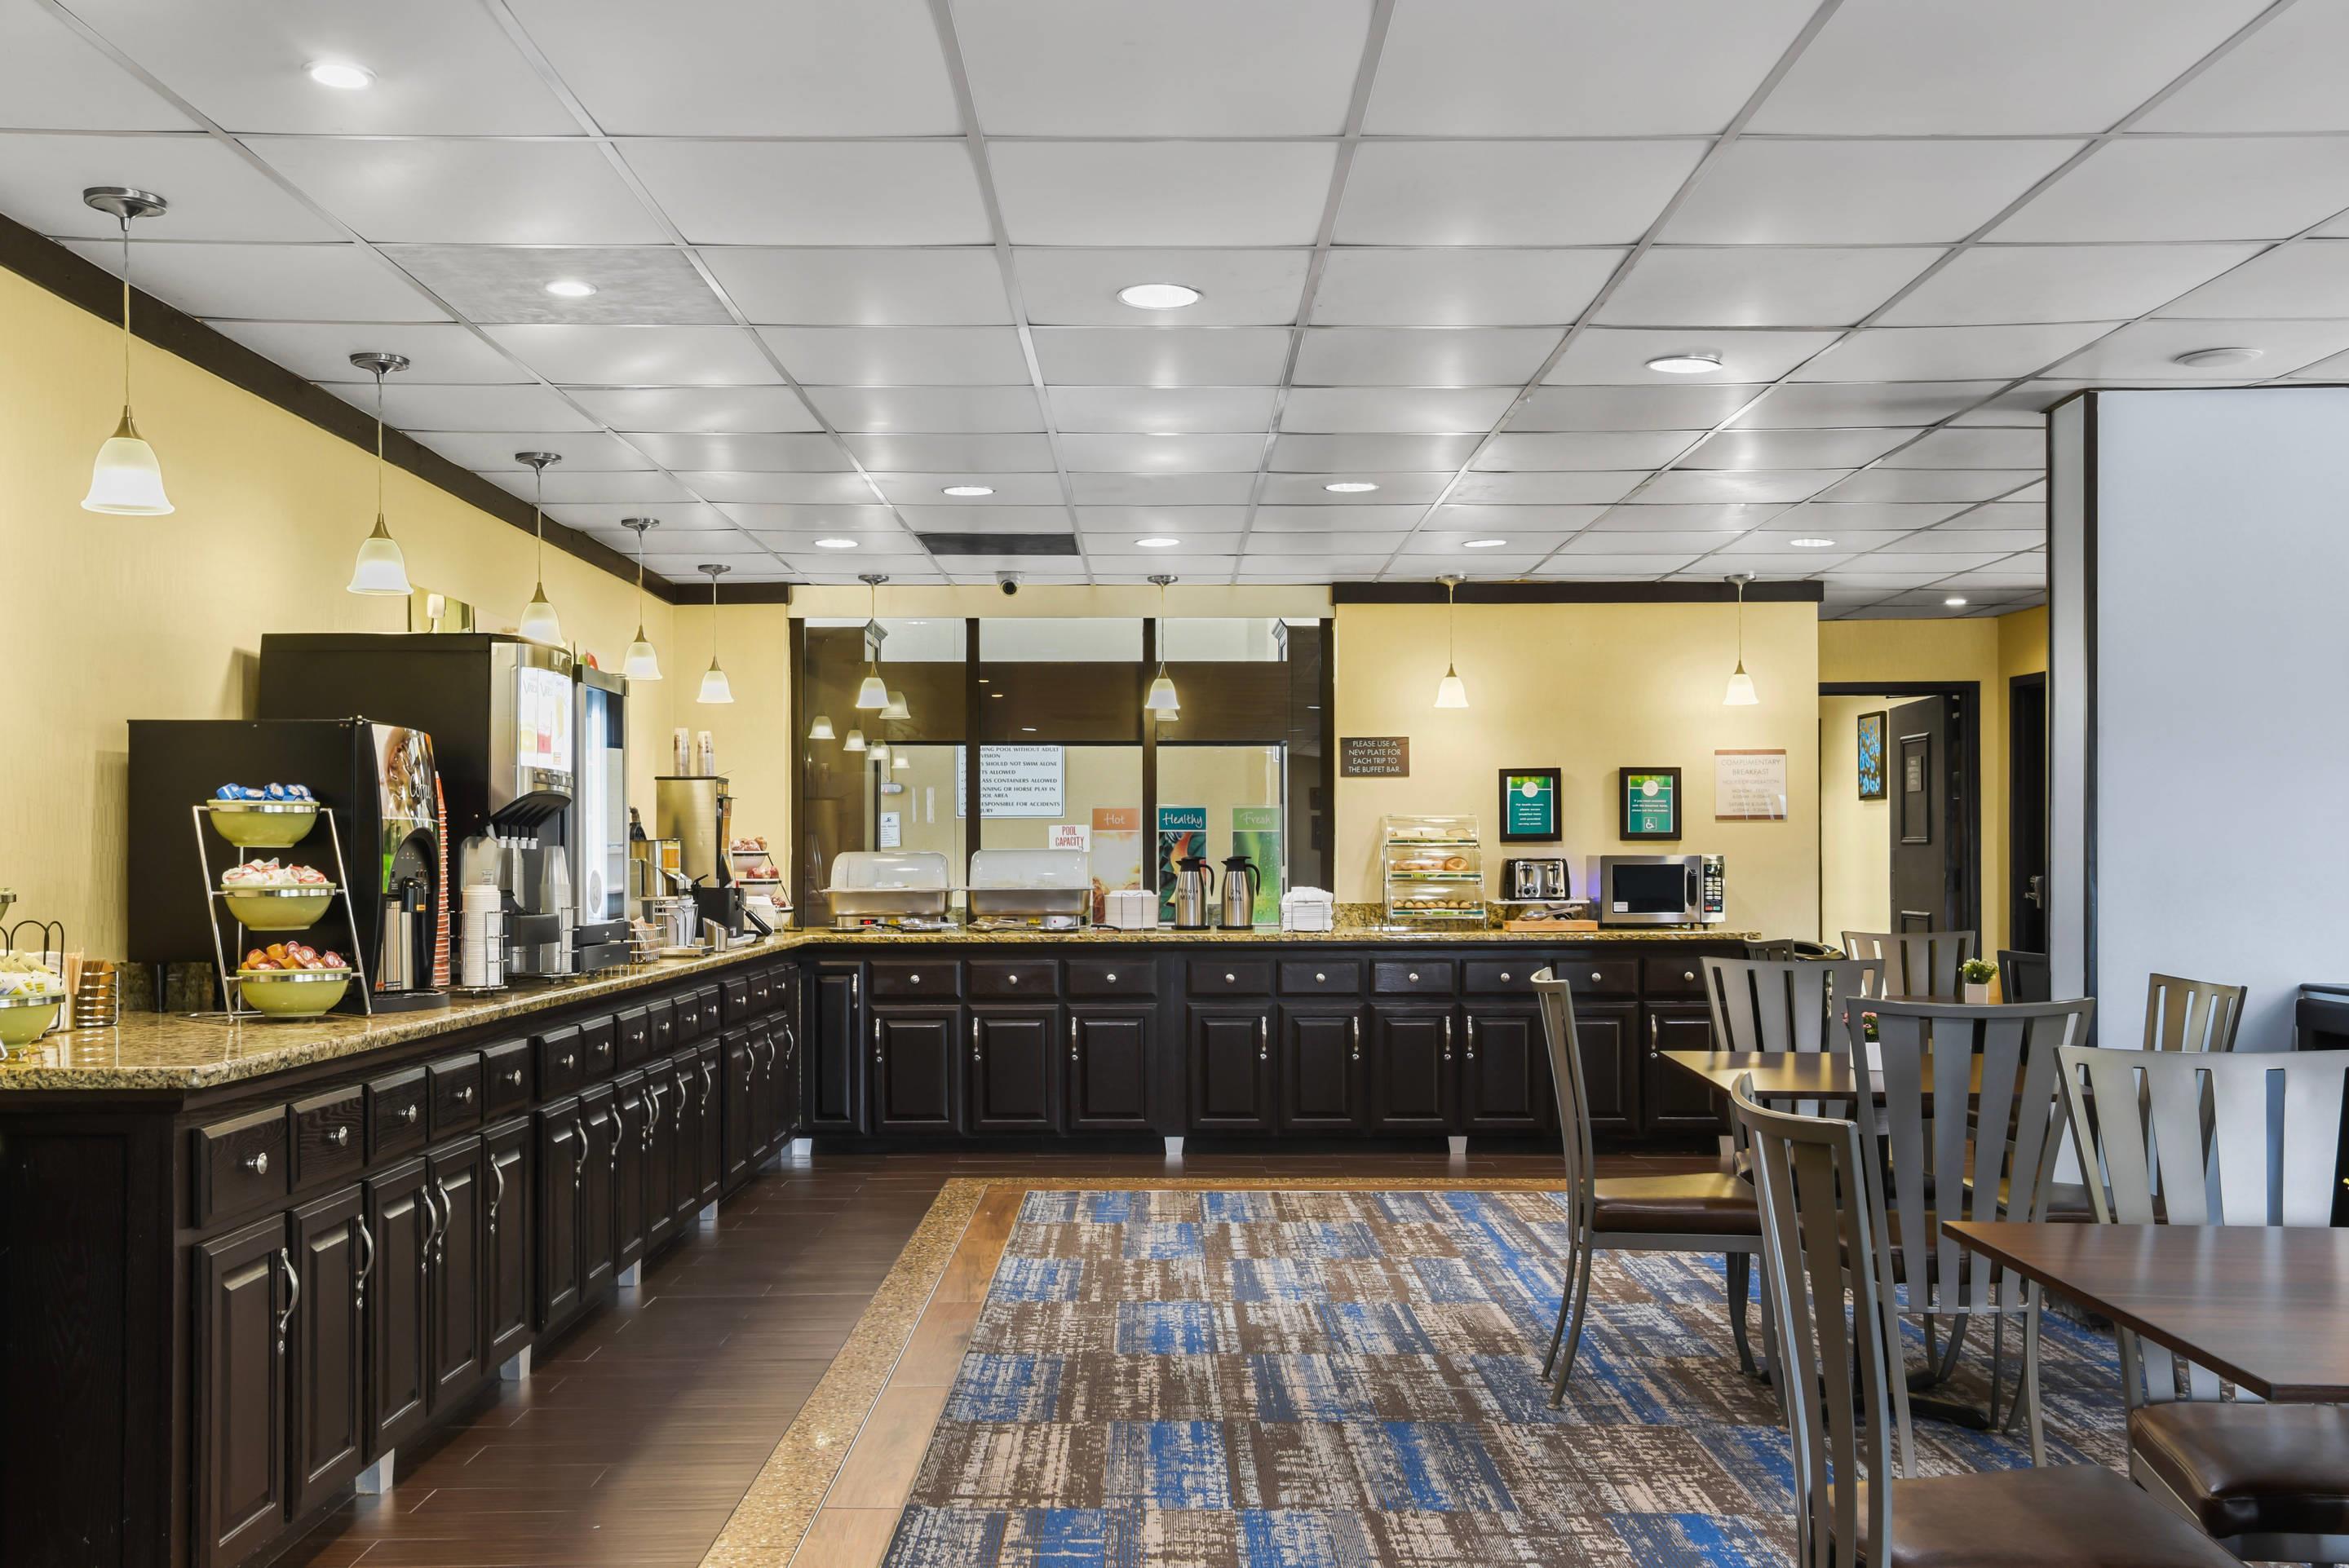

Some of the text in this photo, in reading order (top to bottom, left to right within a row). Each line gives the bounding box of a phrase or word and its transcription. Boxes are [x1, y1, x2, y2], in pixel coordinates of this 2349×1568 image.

[1104, 813, 1126, 827] Hot
[1162, 812, 1203, 828] Healthy
[1241, 811, 1272, 825] Fresh
[1062, 826, 1077, 836] POOL
[1055, 837, 1085, 848] CAPACITY
